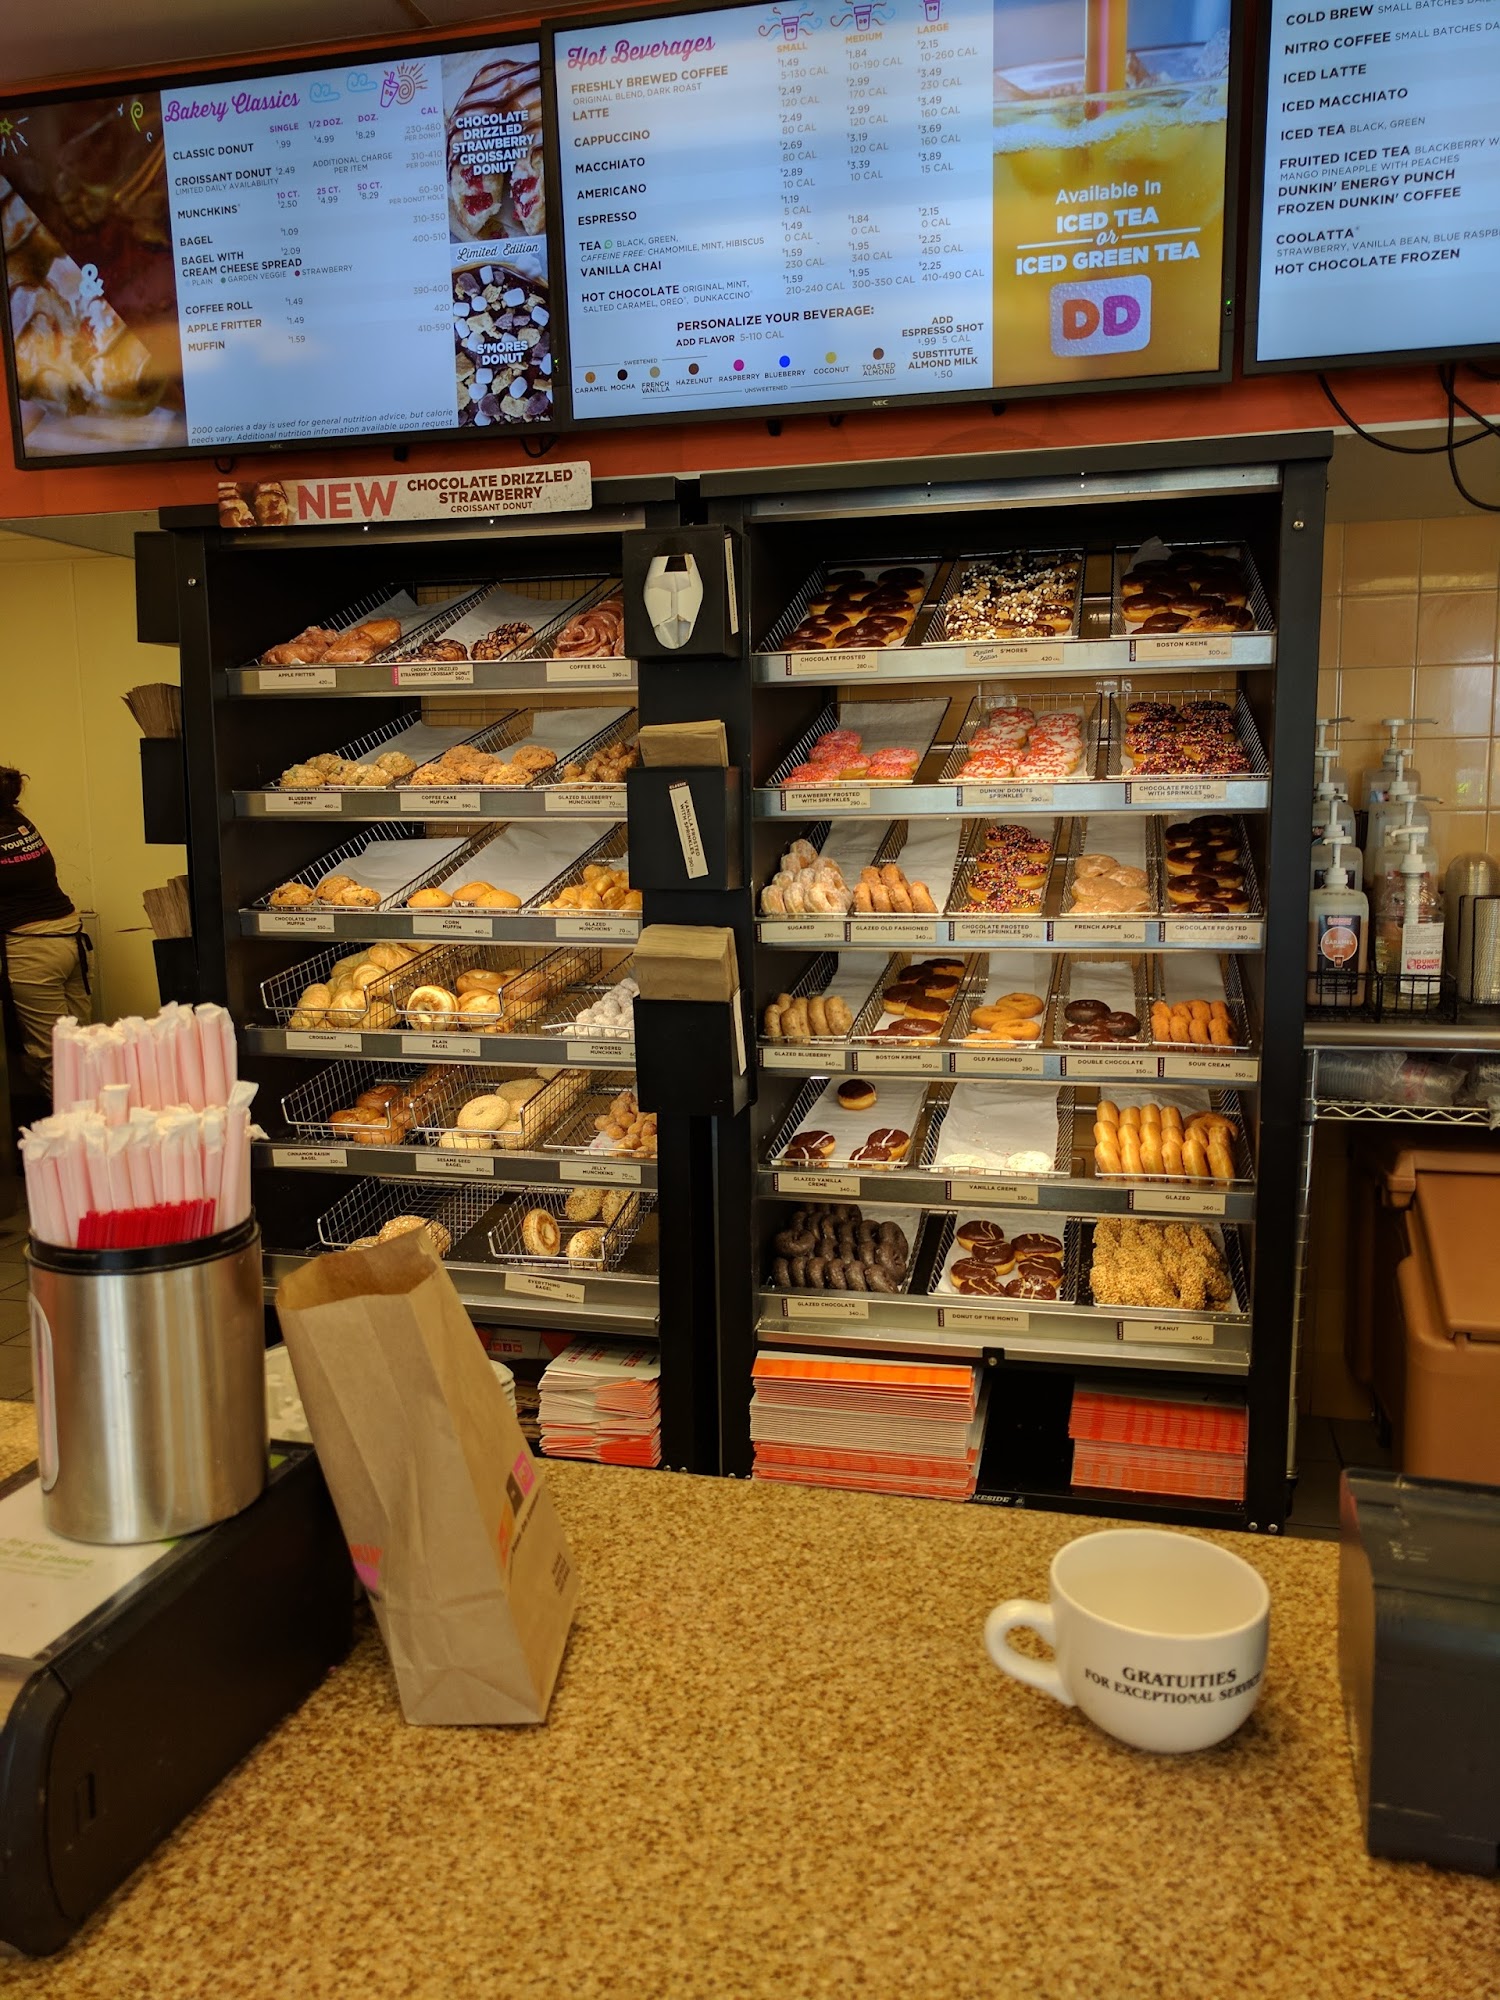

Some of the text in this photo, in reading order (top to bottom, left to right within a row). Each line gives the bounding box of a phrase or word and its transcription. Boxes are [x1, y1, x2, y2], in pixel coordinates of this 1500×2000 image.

[1286, 5, 1373, 26] COLD BREW
[917, 23, 949, 34] LARGE
[846, 33, 882, 43] MEDIUM
[1284, 24, 1482, 55] NITRO COFFEE SMALL BATCHES
[568, 36, 715, 70] Hot Beverages
[777, 42, 807, 52] SMALL
[571, 66, 728, 94] FRESHLY BREWED COFFEE
[1284, 64, 1366, 84] ICED LATTE
[573, 82, 702, 105] ORIGINAL BLEND, DARK ROAST
[1282, 88, 1408, 112] ICED MACCHIATO
[164, 90, 300, 123] Bakery Classics
[573, 108, 610, 121] LATTE
[269, 122, 299, 133] SINGLE
[309, 118, 343, 128] 1/2 DOZ.
[456, 110, 529, 128] CHOCOLATE
[463, 123, 523, 140] DRIZZLED
[1281, 117, 1425, 141] ICED TEA BLACK, GREEN
[453, 134, 534, 153] STRAWBERRY
[574, 130, 650, 147] CAPPUCCINO
[173, 143, 254, 160] CLASSIC DONUT
[461, 148, 528, 165] CROISSANT
[1279, 145, 1410, 169] FRUITED ICED TEA
[474, 161, 516, 175] DONUT
[575, 157, 645, 173] MACCHIATO
[175, 167, 271, 187] CROISSANT DONUT
[1279, 169, 1455, 197] DUNKIN' ENERGY PUNCH
[577, 184, 647, 200] AMERICANO
[1056, 180, 1161, 204] Available In
[1278, 187, 1461, 215] FROZEN DUNKIN' COFFEE
[578, 211, 637, 225] ESPRESSO
[1057, 207, 1159, 233] ICED TEA
[180, 235, 213, 247] BAGEL
[579, 235, 678, 251] TEA BLACK, GREEN,
[1097, 230, 1119, 245] or
[181, 252, 244, 265] BAGEL WITH
[457, 242, 539, 261] Limited Edition
[1016, 241, 1200, 275] ICED GREEN TEA
[182, 258, 302, 278] CREAM CHEESE SPREAD
[581, 261, 662, 277] VANILLA CHAI
[1275, 249, 1460, 275] HOT CHOCOLATE FROZEN
[582, 280, 749, 302] HOT CHOCOLATE ORIGINAL, MINT,
[185, 301, 253, 315] COFFEE ROLL
[187, 319, 262, 333] APPLE FRITTER
[677, 305, 874, 331] PERSONALIZE YOUR BEVERAGE:
[932, 316, 953, 324] ADD
[902, 323, 984, 337] ESPRESSO SHOT
[188, 341, 225, 351] MUFFIN
[477, 341, 528, 354] S'MORES
[676, 335, 735, 346] ADD FLAVOR
[482, 352, 524, 365] DONUT
[912, 347, 973, 359] SUBSTITUTE
[908, 357, 978, 369] ALMOND MILK
[407, 469, 573, 492] CHOCOLATE DRIZZLED
[296, 480, 398, 521] NEW
[439, 487, 543, 504] STRAWBERRY
[451, 502, 532, 513] CROISSANT DONUT
[1122, 1666, 1237, 1688] GRATUITIES
[1085, 1668, 1109, 1689] FOR
[1115, 1683, 1215, 1704] EXCEPTIONAL
